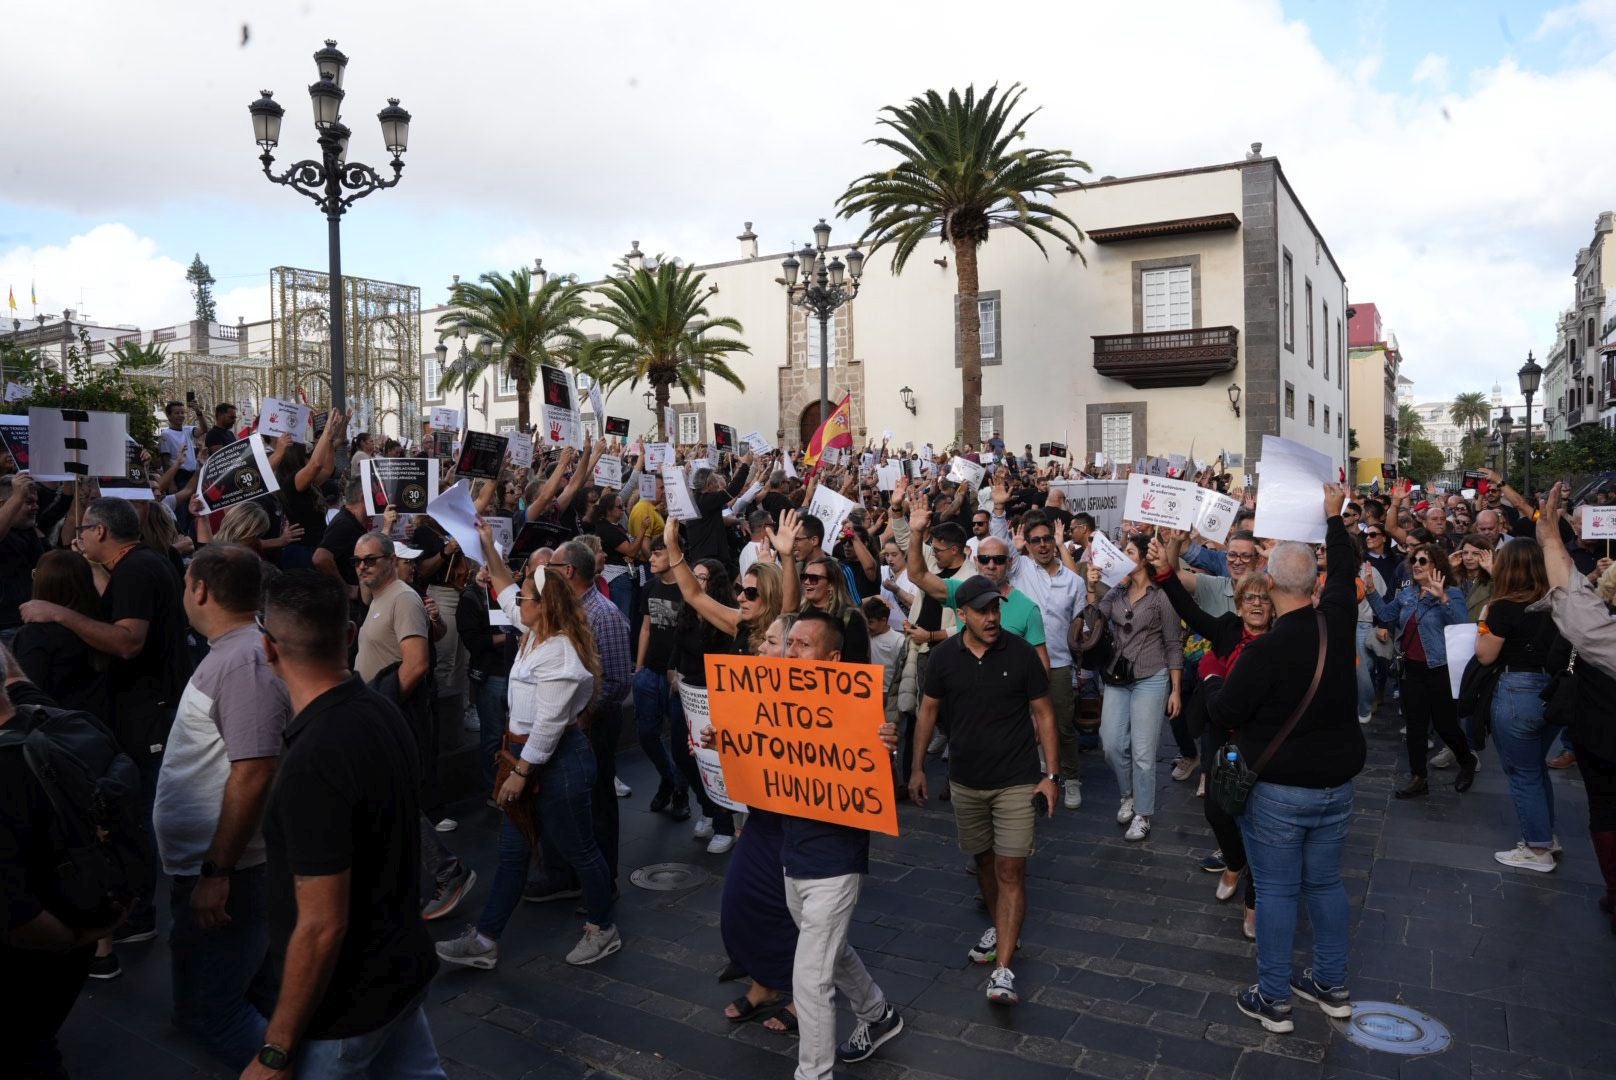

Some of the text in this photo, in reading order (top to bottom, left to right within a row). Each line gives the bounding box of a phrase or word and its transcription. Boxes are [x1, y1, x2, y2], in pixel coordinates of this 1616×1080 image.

[241, 473, 252, 483] 30
[714, 664, 873, 699] IMPUESTOS
[721, 729, 875, 772] AUTONOMOS
[763, 768, 882, 814] HUNDIDOS
